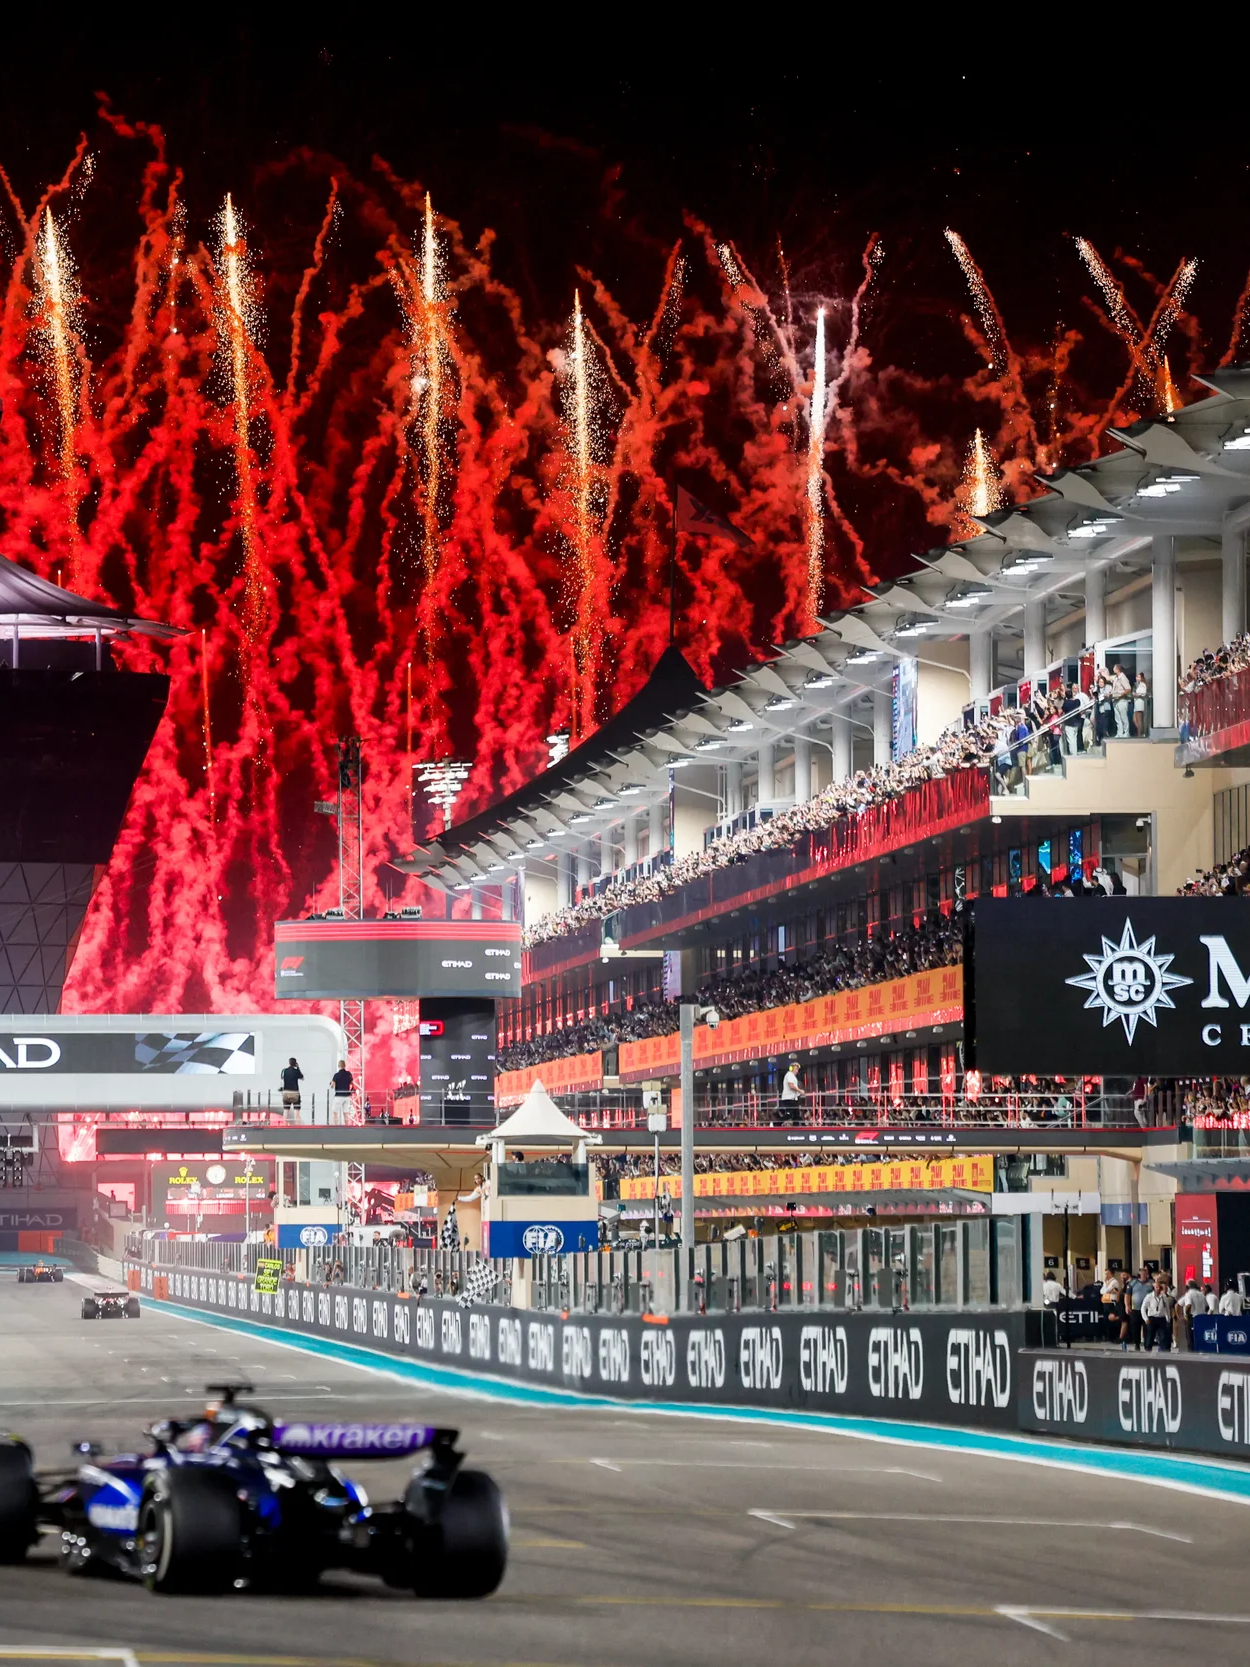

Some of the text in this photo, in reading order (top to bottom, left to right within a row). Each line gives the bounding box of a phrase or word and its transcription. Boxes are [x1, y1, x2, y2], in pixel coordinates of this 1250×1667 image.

[441, 959, 473, 969] ETIHAD
[168, 1176, 198, 1185] ROLEX
[234, 1176, 264, 1184] ROLEX
[1227, 1332, 1246, 1343] FIA
[599, 1327, 630, 1382] ETIHAD
[640, 1328, 676, 1386] ETIHAD
[686, 1328, 726, 1388] ETIHAD
[740, 1327, 783, 1389] ETIHAD
[800, 1326, 848, 1394] ETIHAD
[868, 1327, 924, 1399] ETIHAD
[946, 1328, 1011, 1408] ETIHAD
[1032, 1359, 1088, 1424] ETIHAD
[1118, 1364, 1182, 1433] ETIHAD
[313, 1424, 425, 1449] kraken
